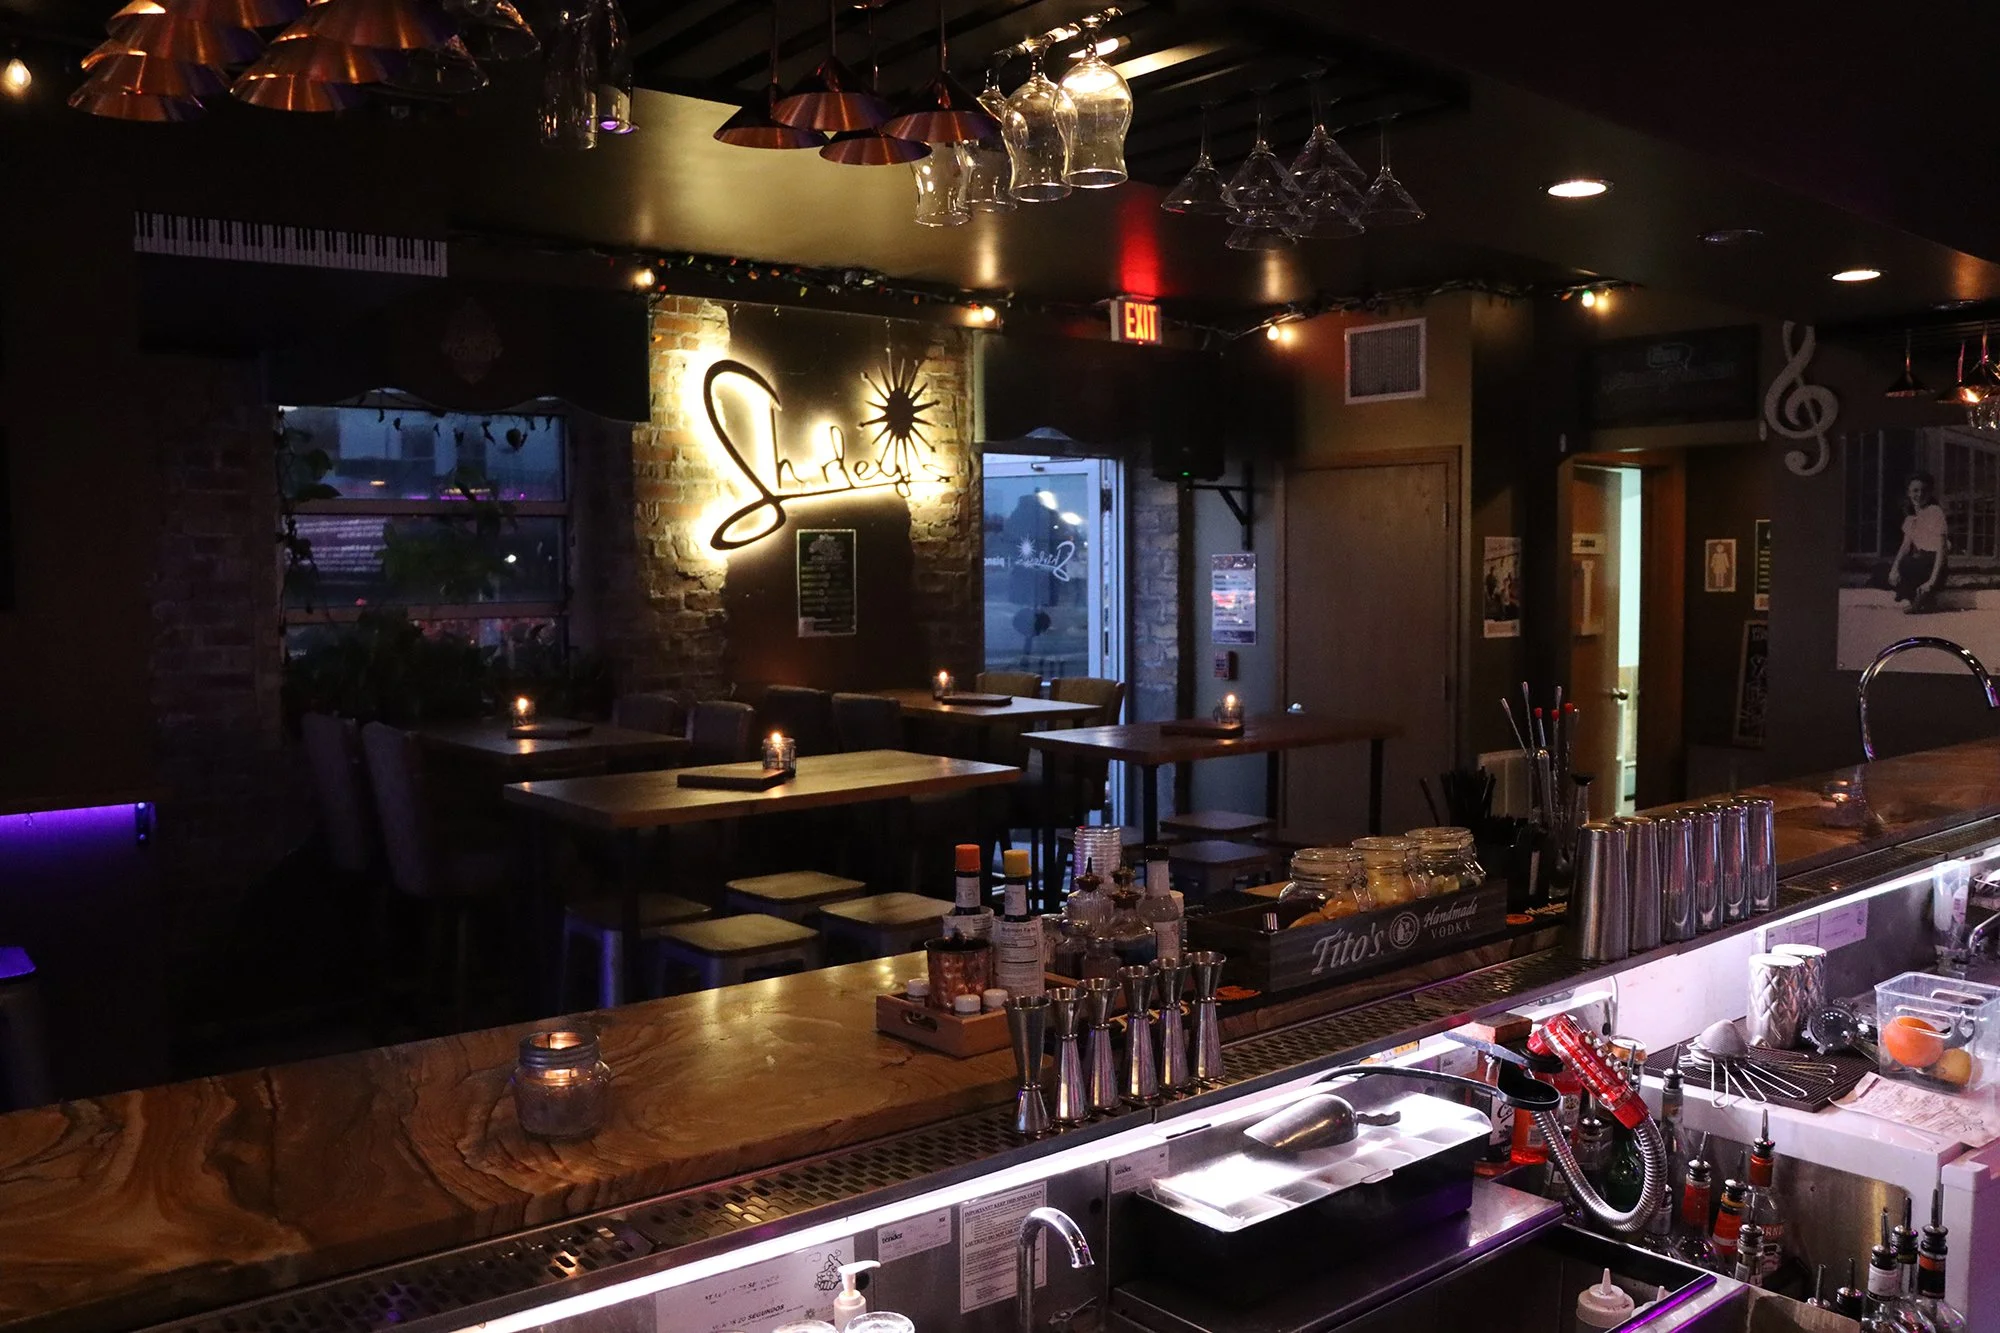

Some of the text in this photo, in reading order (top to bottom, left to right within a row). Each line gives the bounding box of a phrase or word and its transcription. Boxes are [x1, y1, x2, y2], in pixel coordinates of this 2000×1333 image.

[1125, 302, 1157, 341] EXIT
[704, 360, 952, 551] Shrley's
[1424, 896, 1478, 928] Handmade
[1430, 920, 1471, 940] VODKA
[1312, 922, 1384, 975] Tito's
[747, 1304, 785, 1321] SEGUNDOS
